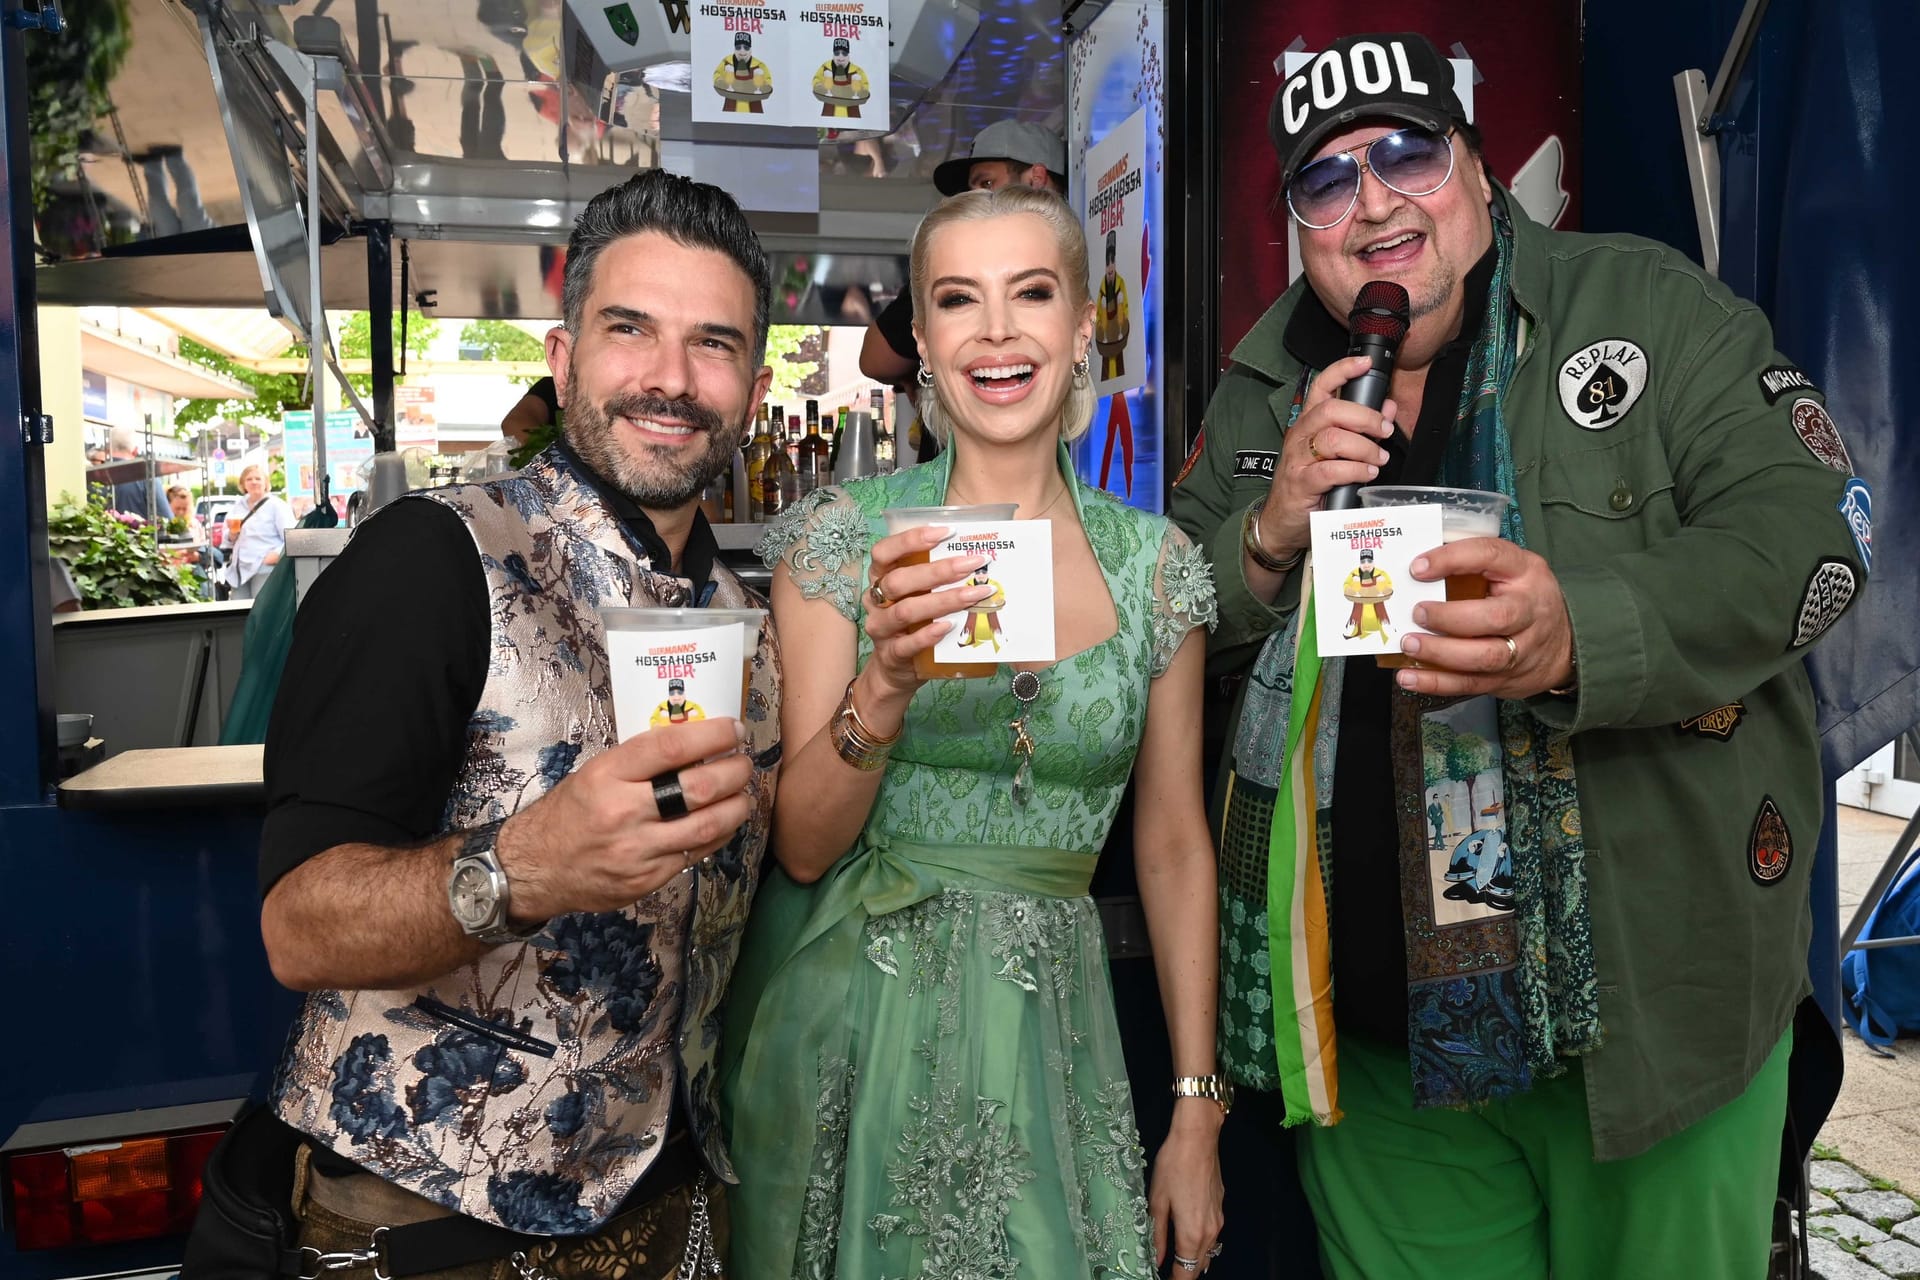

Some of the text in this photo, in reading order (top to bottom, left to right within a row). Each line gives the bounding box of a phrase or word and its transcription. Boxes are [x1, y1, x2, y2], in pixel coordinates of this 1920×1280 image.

[700, 5, 787, 21] HOSSAHOSSA
[799, 11, 884, 27] HOSSAHOSSA
[724, 17, 762, 34] BIER
[823, 23, 860, 40] BIER
[1282, 41, 1429, 135] COOL
[1089, 168, 1141, 220] HOSSAHOSSA
[1101, 199, 1123, 236] BIER
[1565, 345, 1640, 380] REPLAY
[1590, 376, 1617, 404] 81
[1241, 456, 1261, 470] ONE
[1330, 528, 1403, 540] HOSSAHOSSA
[947, 541, 1015, 551] HOSSAHOSSA
[1351, 537, 1382, 550] BIER
[635, 652, 717, 666] HOSSAHOSSA
[657, 664, 695, 679] BIER
[1759, 854, 1786, 876] PANTHER
